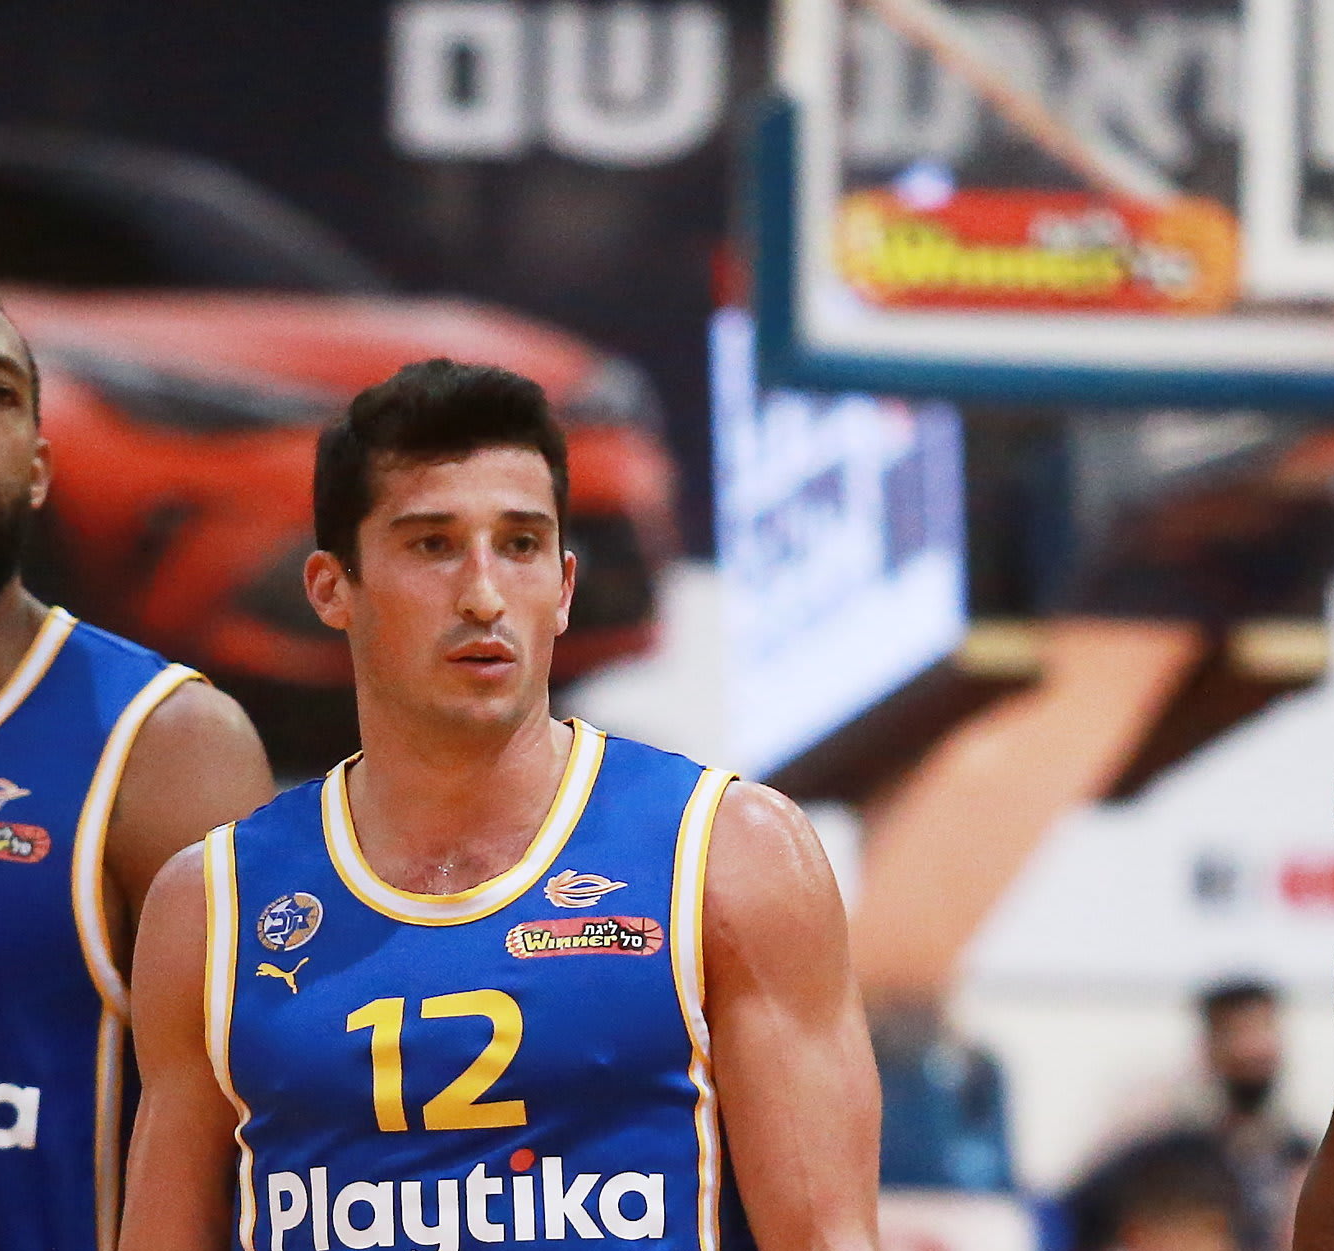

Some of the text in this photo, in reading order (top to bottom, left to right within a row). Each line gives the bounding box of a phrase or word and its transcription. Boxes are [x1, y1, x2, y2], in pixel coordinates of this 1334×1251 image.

[387, 3, 727, 170] שם
[583, 921, 618, 935] ליגת
[346, 988, 528, 1132] 12
